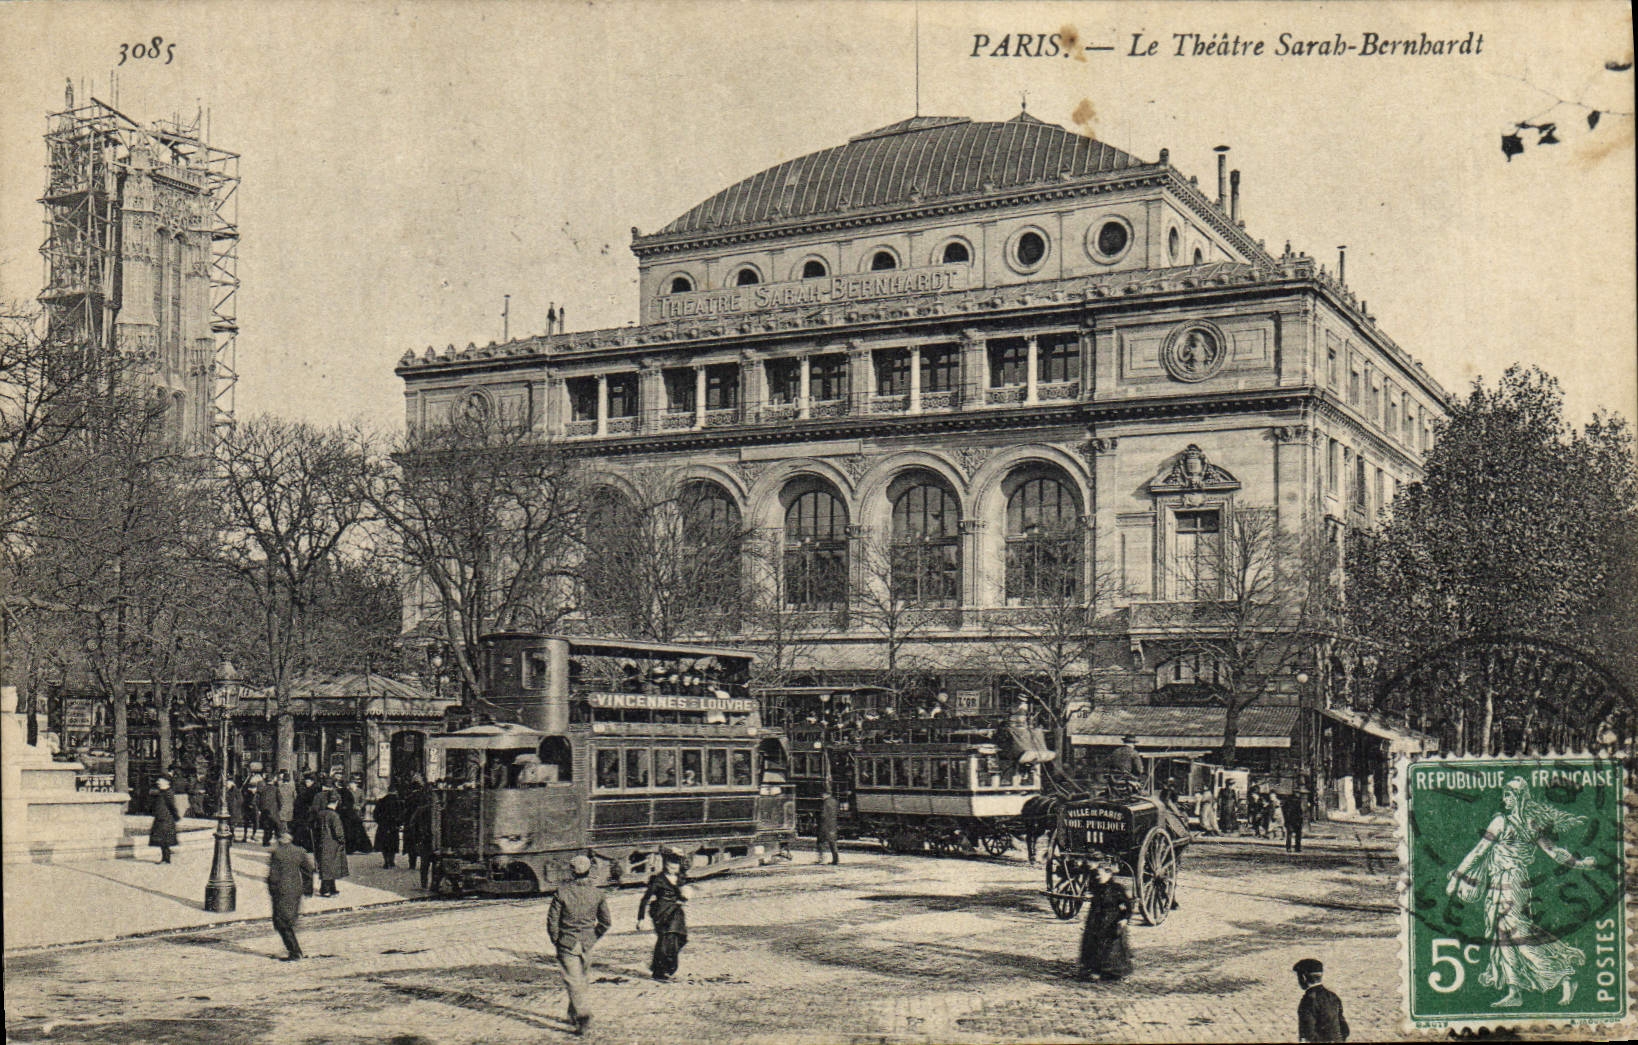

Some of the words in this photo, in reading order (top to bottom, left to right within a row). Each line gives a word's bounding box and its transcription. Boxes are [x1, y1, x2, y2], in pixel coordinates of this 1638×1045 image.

[597, 693, 687, 709] VINCENNES
[700, 700, 751, 711] LOUVRE
[1531, 769, 1613, 787] FRANÇAISE
[1067, 808, 1090, 818] VILLE
[1099, 809, 1122, 820] PARIS
[1596, 918, 1616, 1002] POSTES
